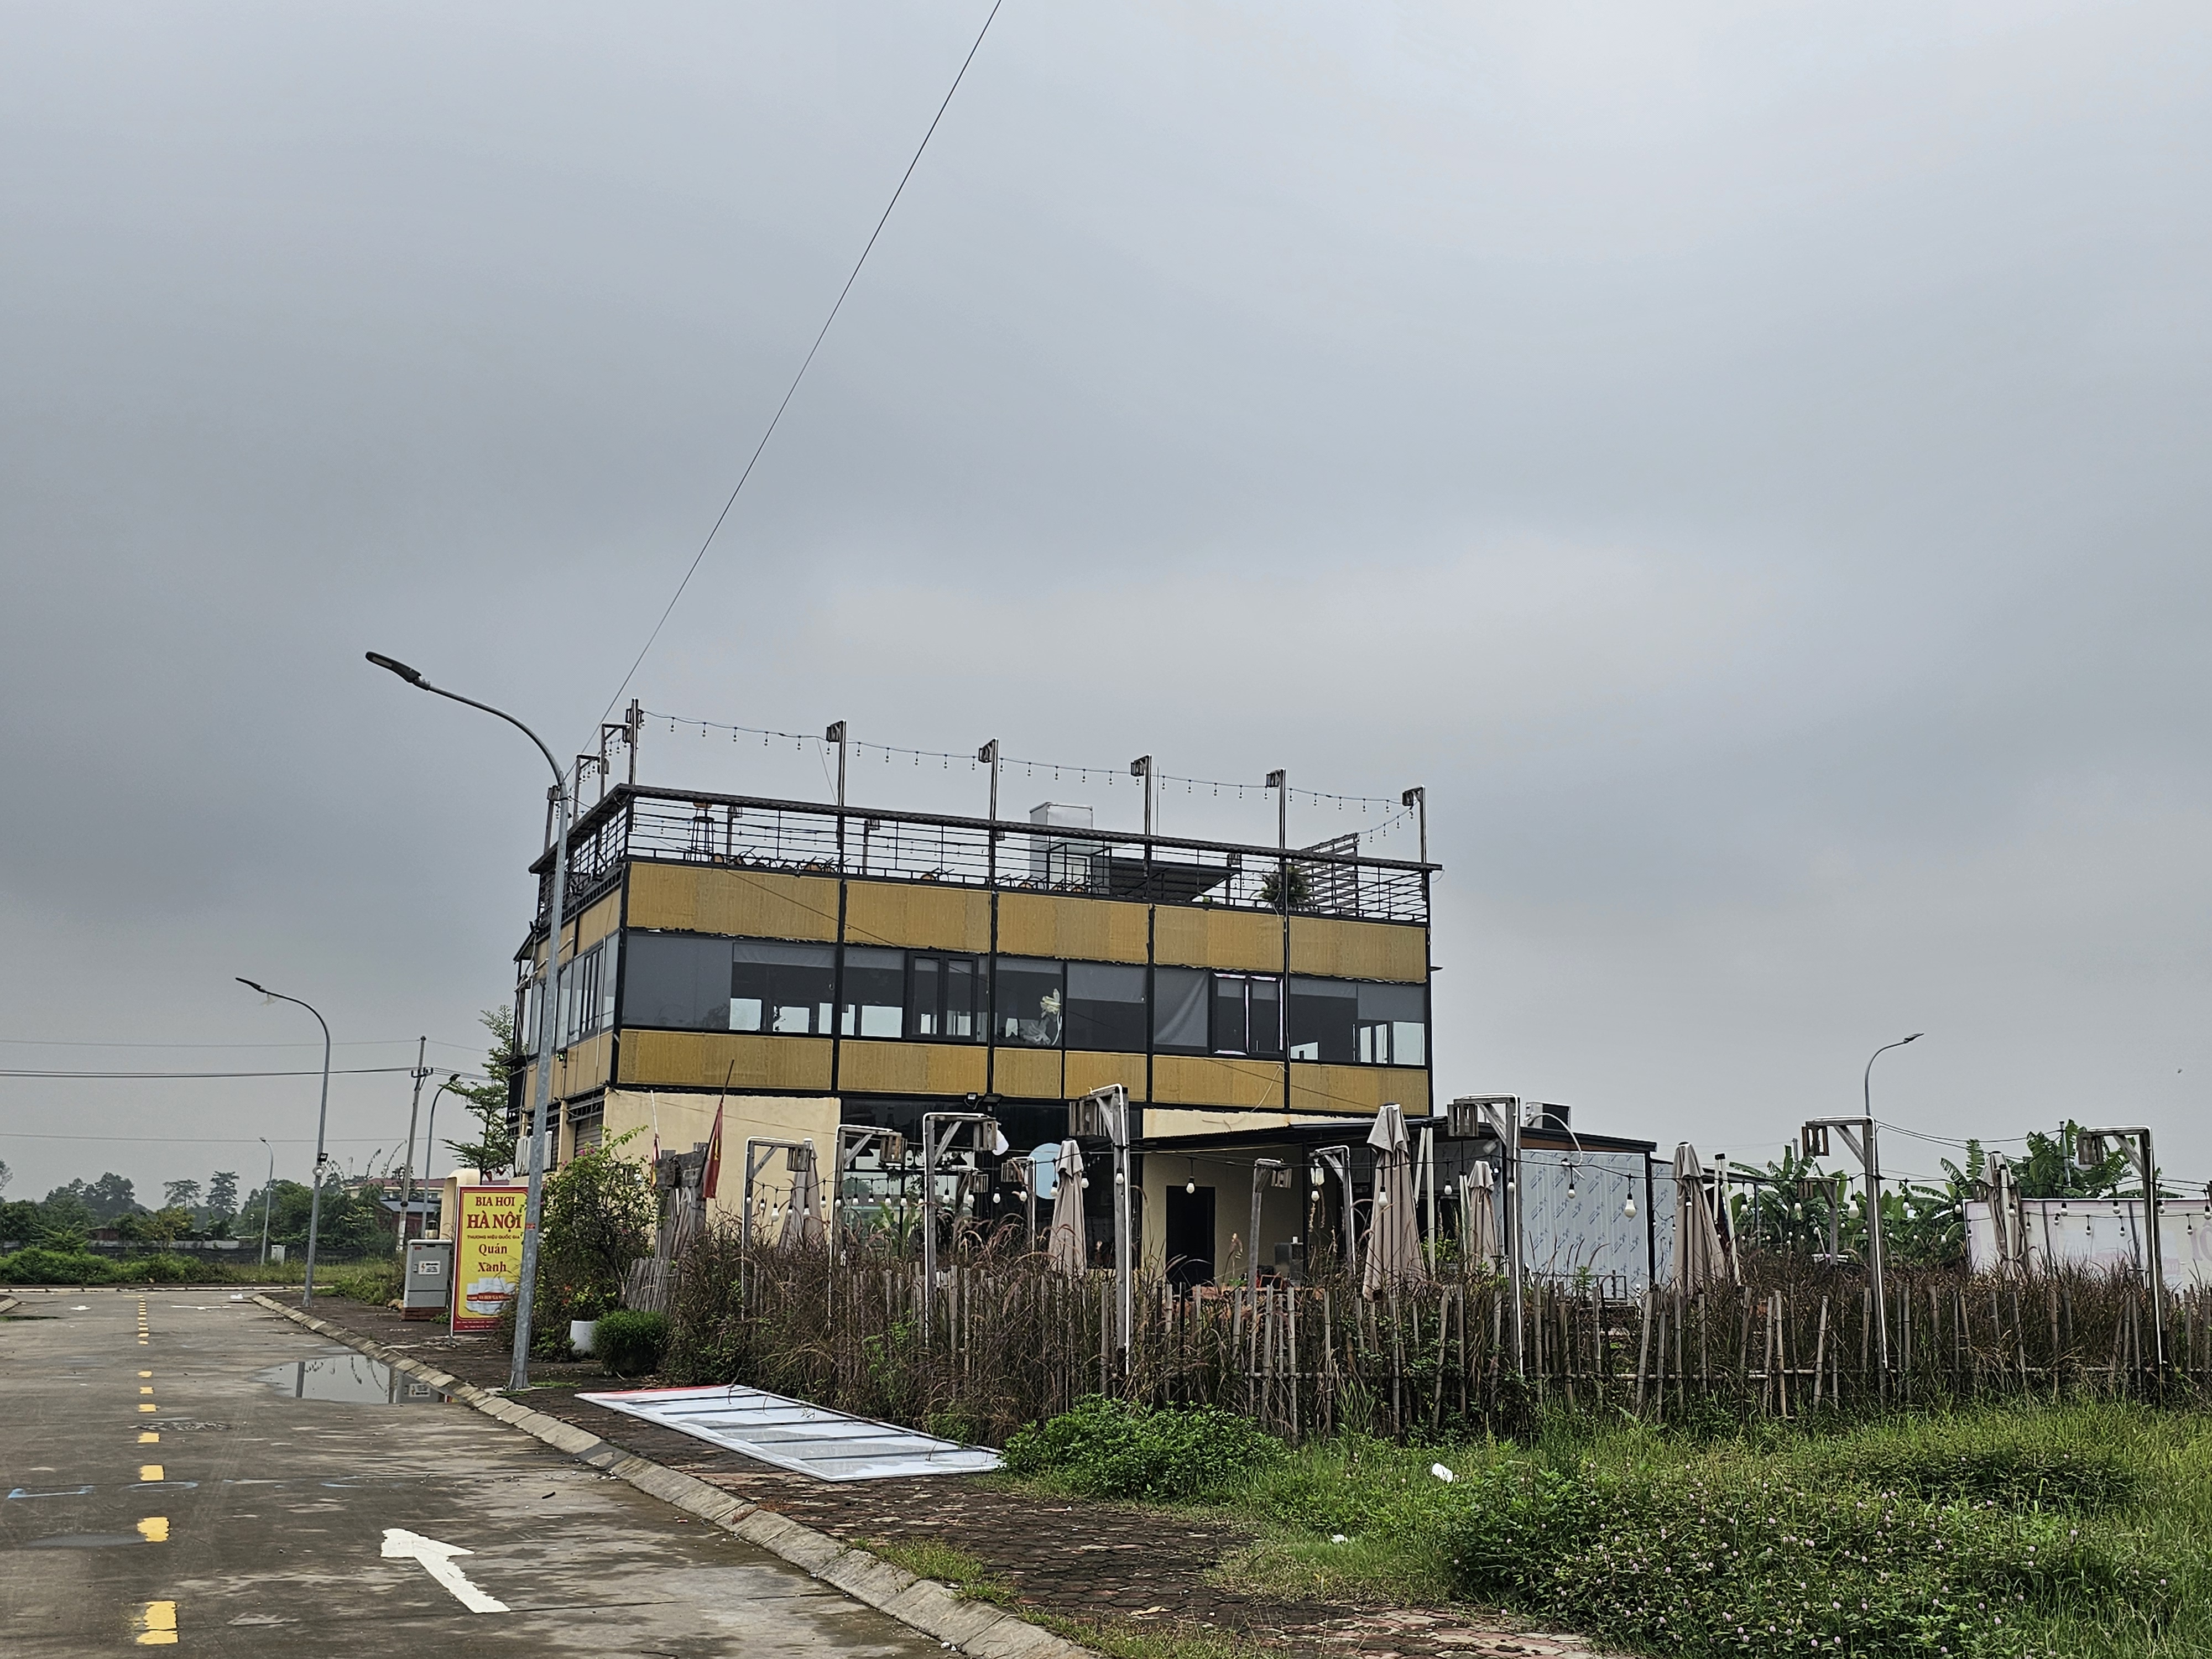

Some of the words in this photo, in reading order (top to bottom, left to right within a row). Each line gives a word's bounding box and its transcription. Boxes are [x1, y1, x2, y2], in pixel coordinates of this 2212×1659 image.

[476, 1196, 493, 1206] BIA
[495, 1196, 515, 1206] HƠI
[467, 1210, 491, 1229] HÀ
[492, 1211, 522, 1232] NỘI
[479, 1243, 507, 1256] Quán
[478, 1261, 507, 1272] Xanh
